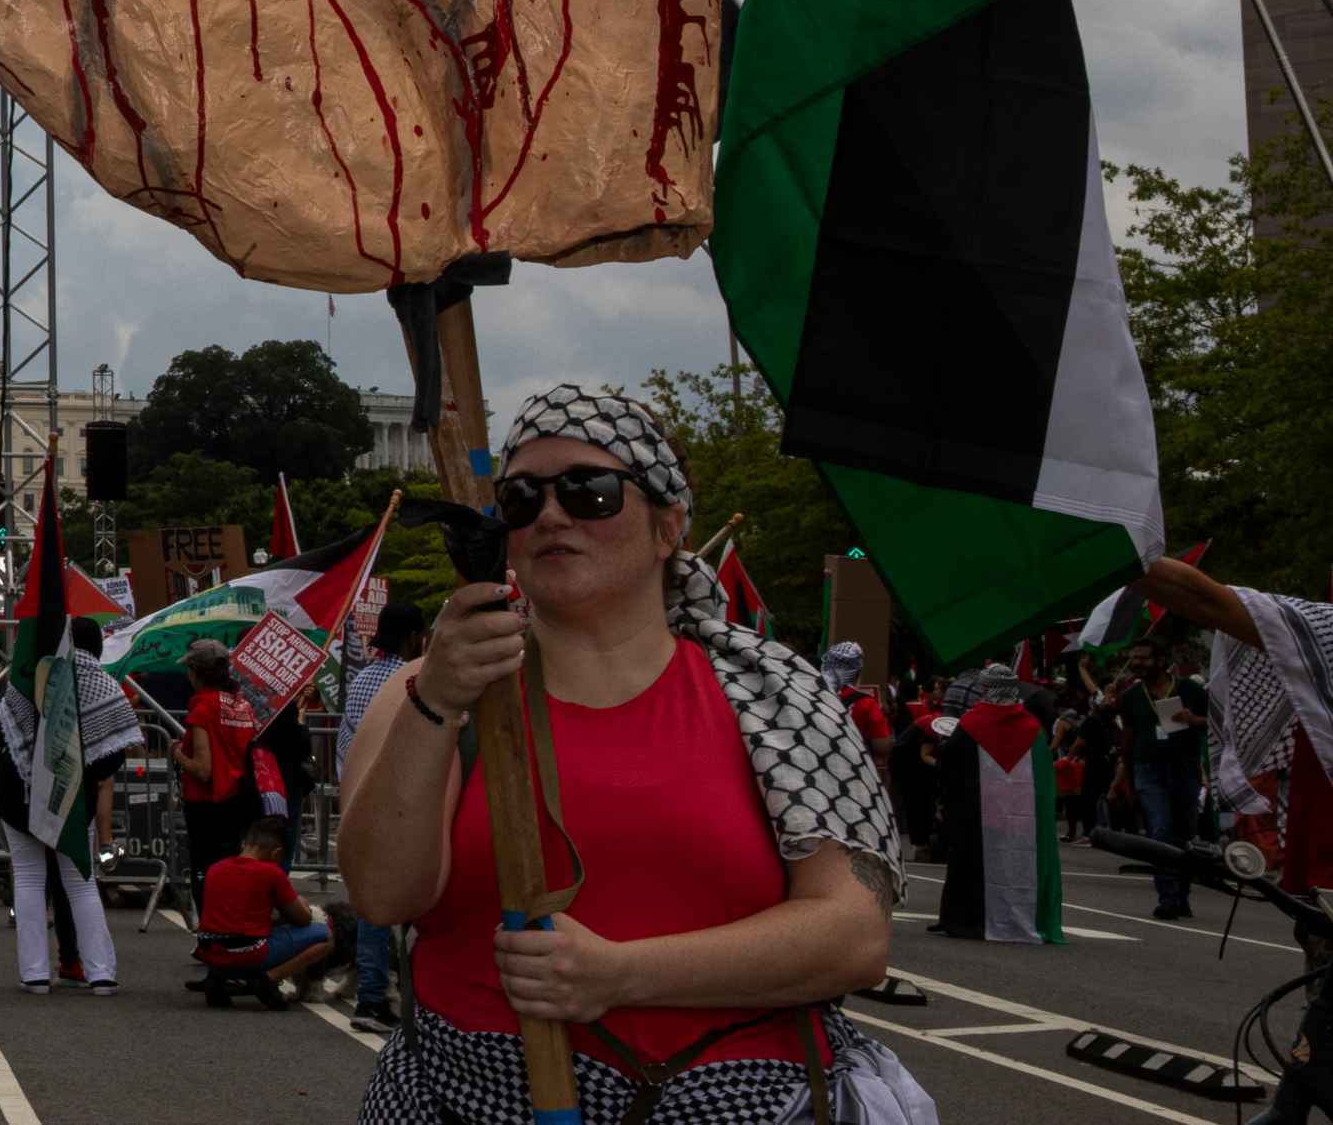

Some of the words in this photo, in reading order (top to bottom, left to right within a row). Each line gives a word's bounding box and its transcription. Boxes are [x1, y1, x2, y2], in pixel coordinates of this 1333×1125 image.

[162, 528, 225, 562] FREE
[254, 626, 311, 679] ISRAEL
[267, 617, 290, 636] STOP
[286, 634, 321, 663] ARMING
[252, 648, 279, 672] FUND
[275, 666, 299, 689] OUR
